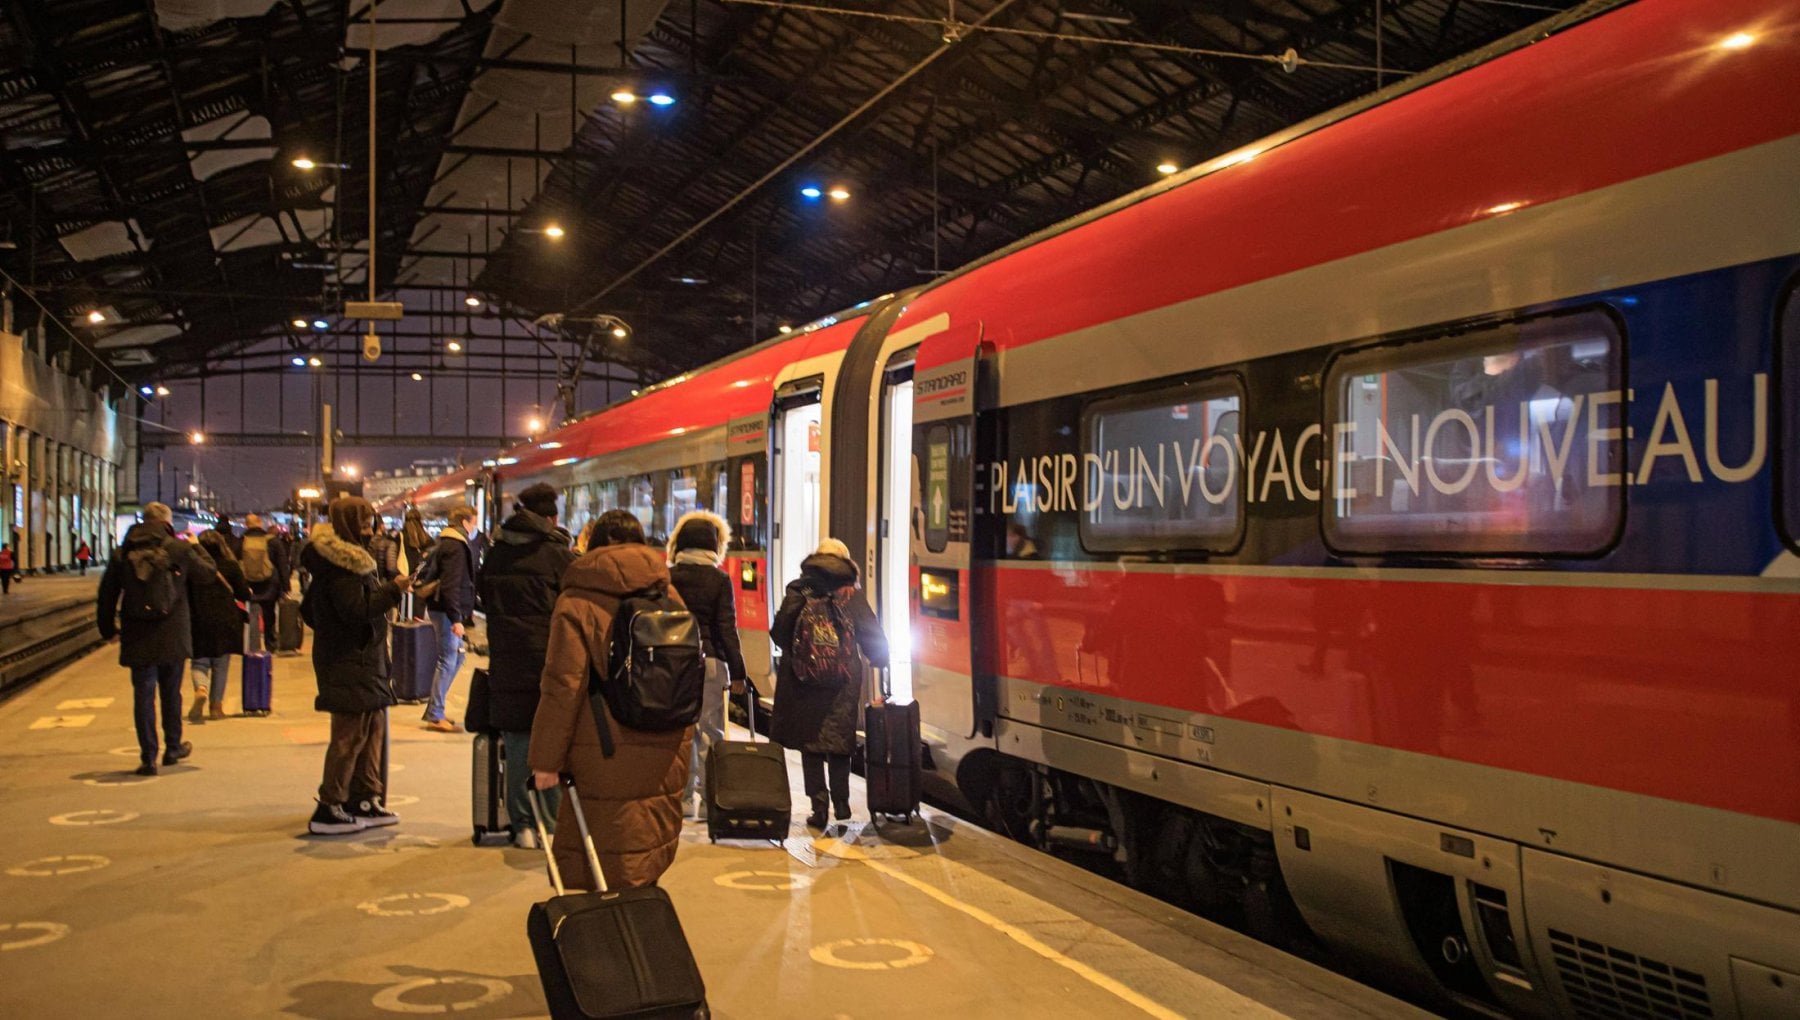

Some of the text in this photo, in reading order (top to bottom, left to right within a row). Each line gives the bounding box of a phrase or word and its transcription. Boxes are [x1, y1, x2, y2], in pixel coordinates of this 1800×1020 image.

[916, 370, 967, 395] STANDARD
[991, 453, 1078, 515] PLAISIR
[1083, 443, 1165, 513] D'UN
[1174, 421, 1358, 507] VOYAGE
[1376, 373, 1768, 498] NOUVEAU
